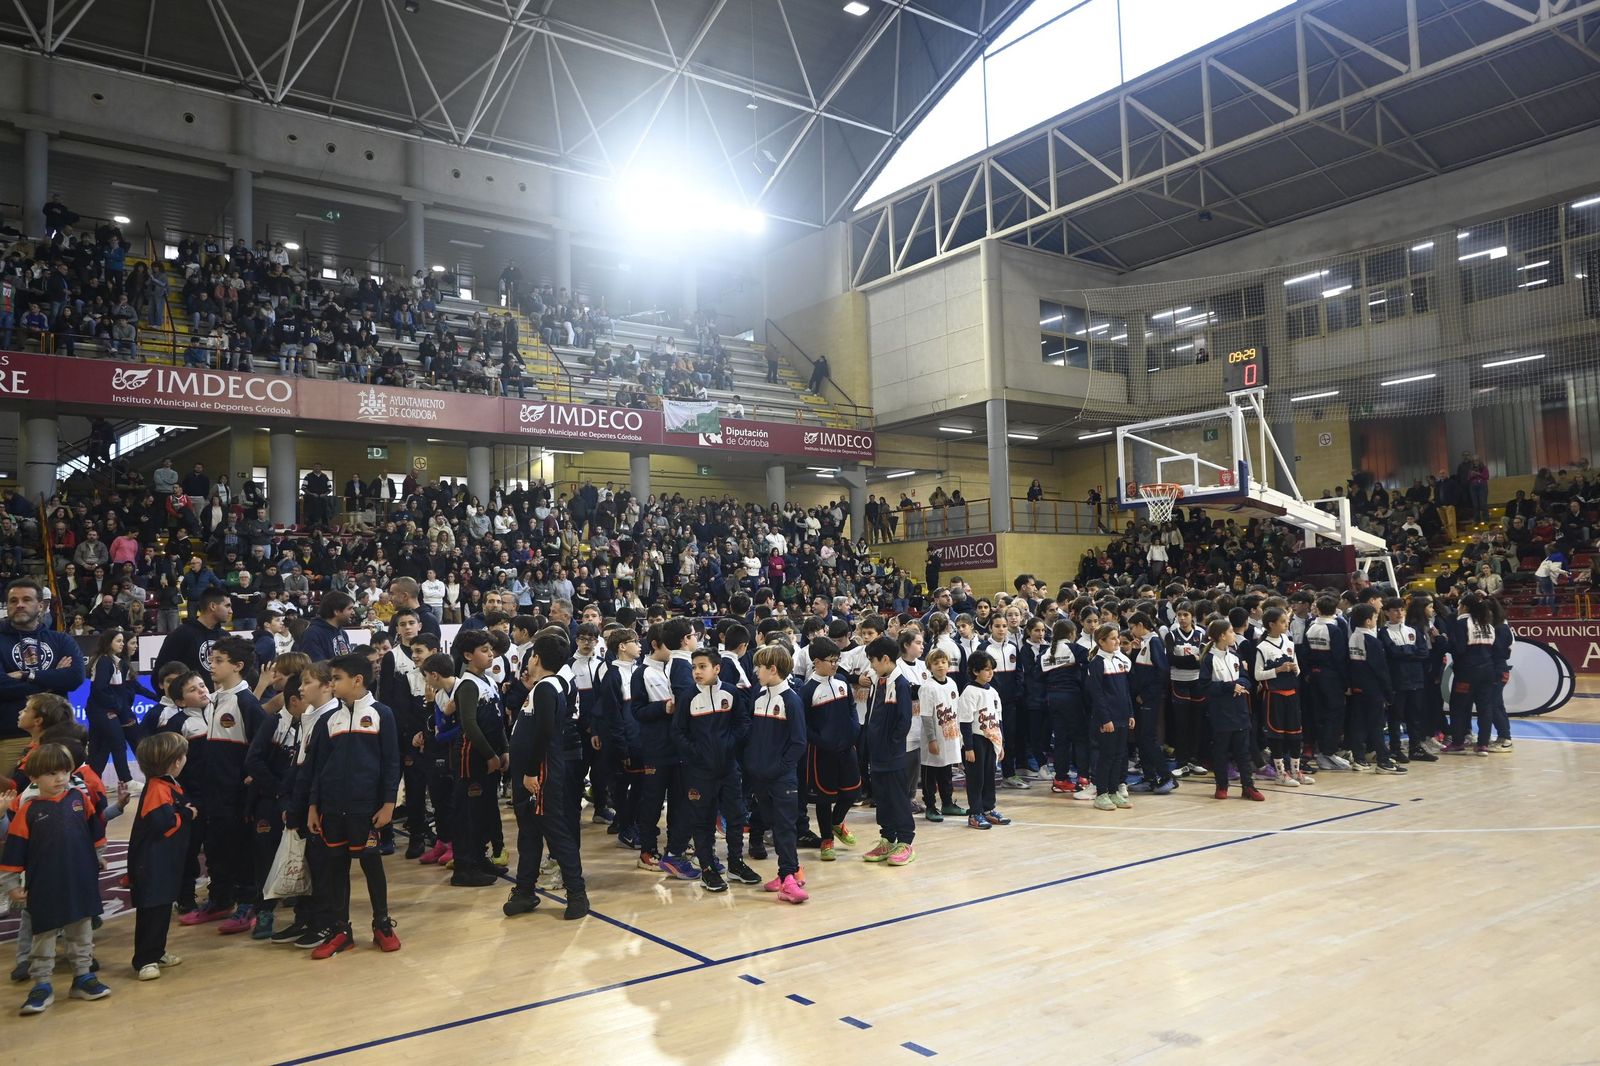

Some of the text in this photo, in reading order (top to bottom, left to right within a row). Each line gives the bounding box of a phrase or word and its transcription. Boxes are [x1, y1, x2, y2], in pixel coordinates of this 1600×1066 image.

[326, 211, 333, 220] 4
[0, 355, 9, 366] S
[1244, 364, 1257, 385] 0
[157, 369, 293, 402] IMDECO
[112, 394, 291, 415] Instituto Municipal de Deportes Córdoba
[389, 395, 445, 410] AYUNTAMIENTO
[389, 407, 398, 417] DE
[550, 404, 643, 431] IMDECO
[520, 425, 547, 435] Instituto
[548, 428, 578, 438] Municipal
[589, 431, 616, 440] Deportes
[617, 432, 642, 441] Córdoba
[726, 426, 769, 439] Diputación
[1207, 431, 1214, 440] K
[726, 437, 769, 448] de Córdoba
[820, 432, 872, 449] IMDECO
[373, 447, 382, 457] D
[701, 466, 708, 475] E
[945, 542, 994, 560] IMDECO
[1547, 626, 1600, 637] MUNICI
